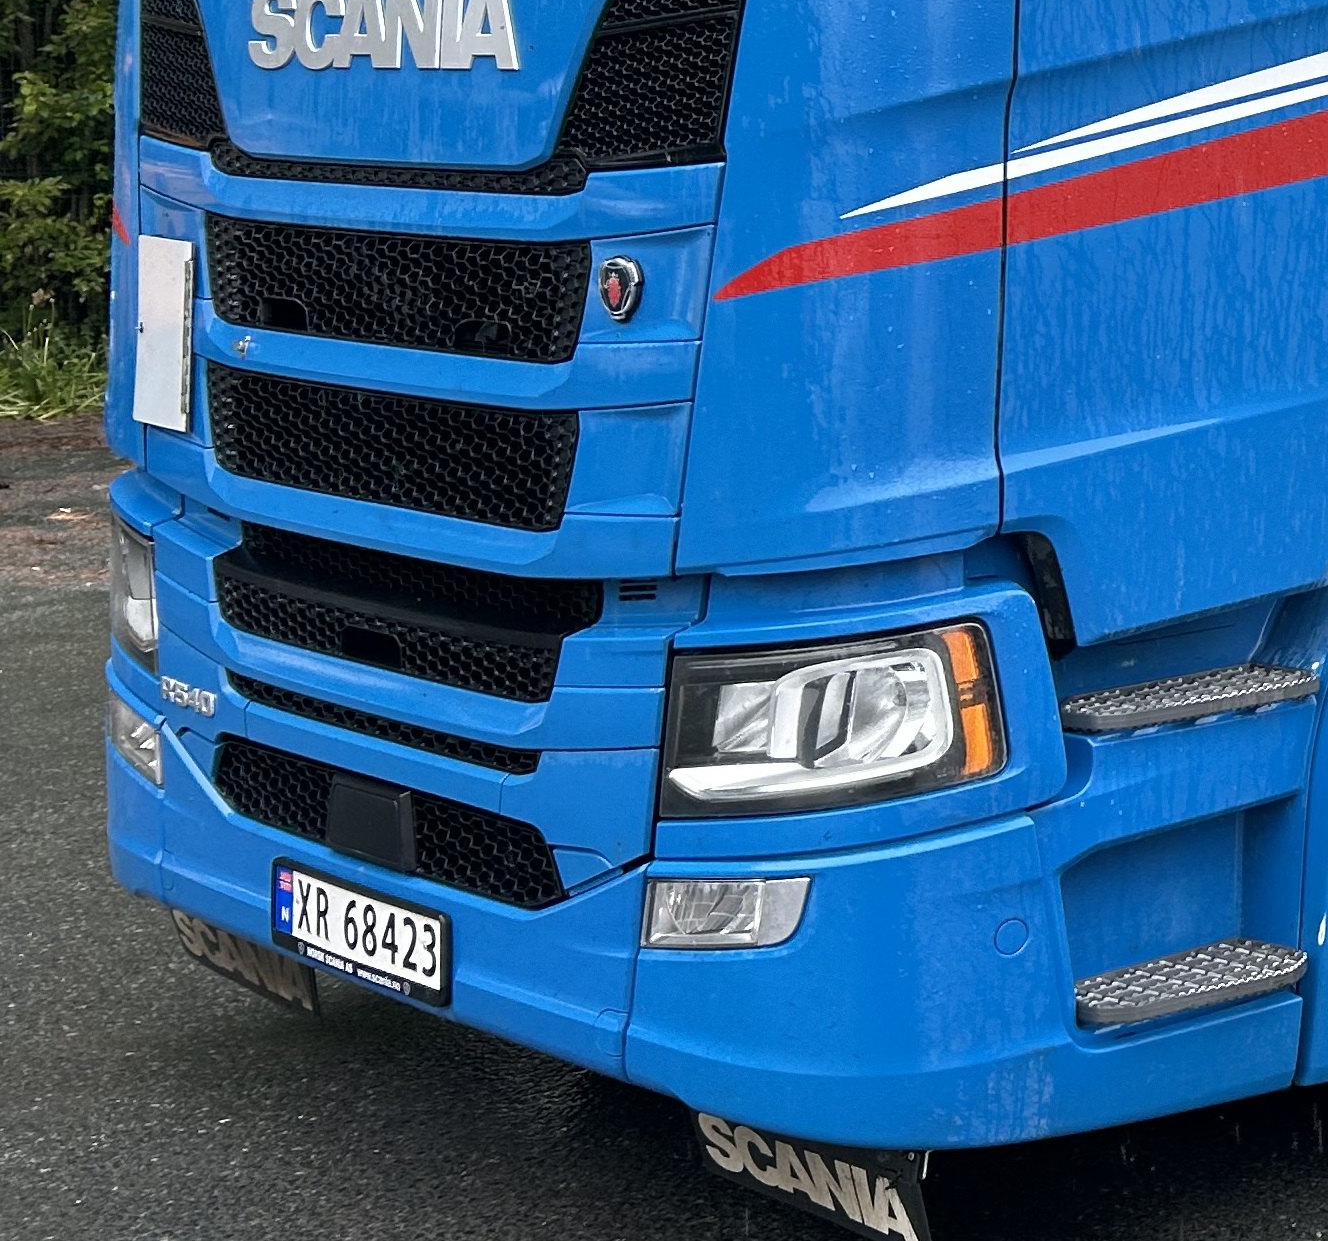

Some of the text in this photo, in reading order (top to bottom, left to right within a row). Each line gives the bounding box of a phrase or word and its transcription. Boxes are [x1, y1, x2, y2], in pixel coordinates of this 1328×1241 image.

[172, 909, 314, 1011] SCANIA
[281, 905, 290, 924] N
[297, 878, 437, 978] XR 68423
[698, 1113, 920, 1241] SCANIA
